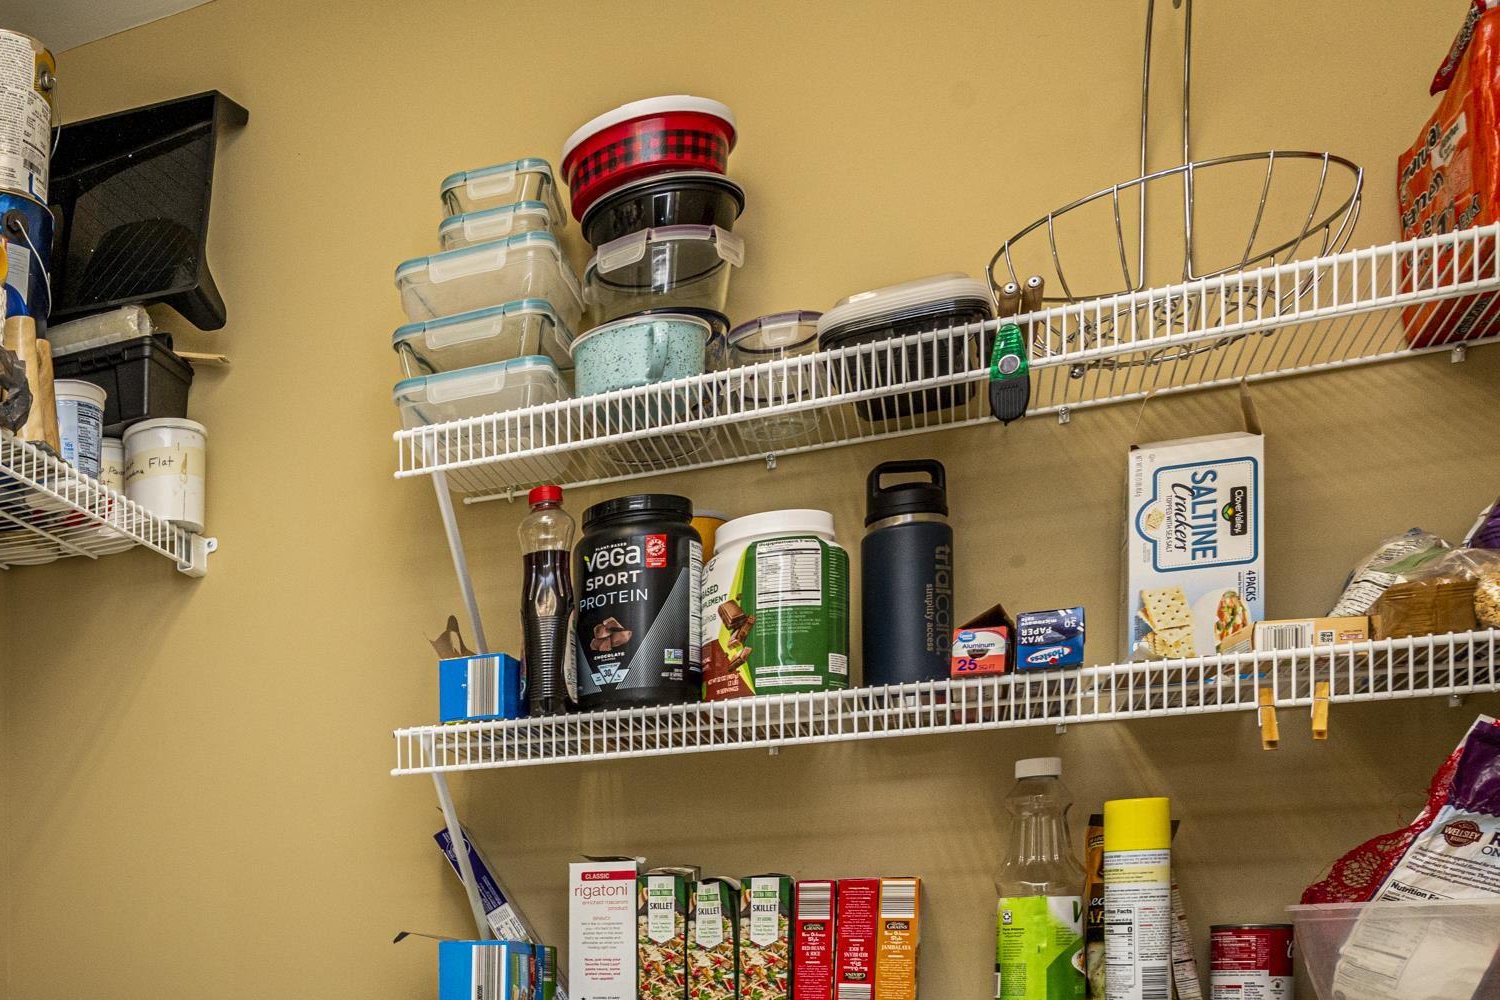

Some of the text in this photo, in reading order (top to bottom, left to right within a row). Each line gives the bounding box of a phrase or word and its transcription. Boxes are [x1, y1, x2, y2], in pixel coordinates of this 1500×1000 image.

[148, 455, 176, 469] Flat
[1165, 495, 1173, 515] TOPPED
[1171, 482, 1195, 552] Crackers
[1191, 469, 1218, 560] SALTINE
[1165, 541, 1173, 553] SALT
[585, 570, 643, 592] SPORT
[1245, 576, 1257, 602] PACKS
[579, 588, 649, 612] PROTEIN
[926, 620, 934, 651] access
[1021, 626, 1052, 636] PAPER
[962, 642, 996, 650] Aluminum
[1021, 635, 1044, 644] WAX
[593, 651, 625, 661] CHOCOLATE
[957, 659, 978, 671] 25
[1444, 826, 1480, 841] WELLSLEY
[574, 883, 628, 900] rigatoni
[1390, 882, 1427, 899] Nutrition
[649, 902, 673, 910] SKILLET
[697, 907, 721, 916] SKILLET
[752, 904, 776, 912] SKILLET
